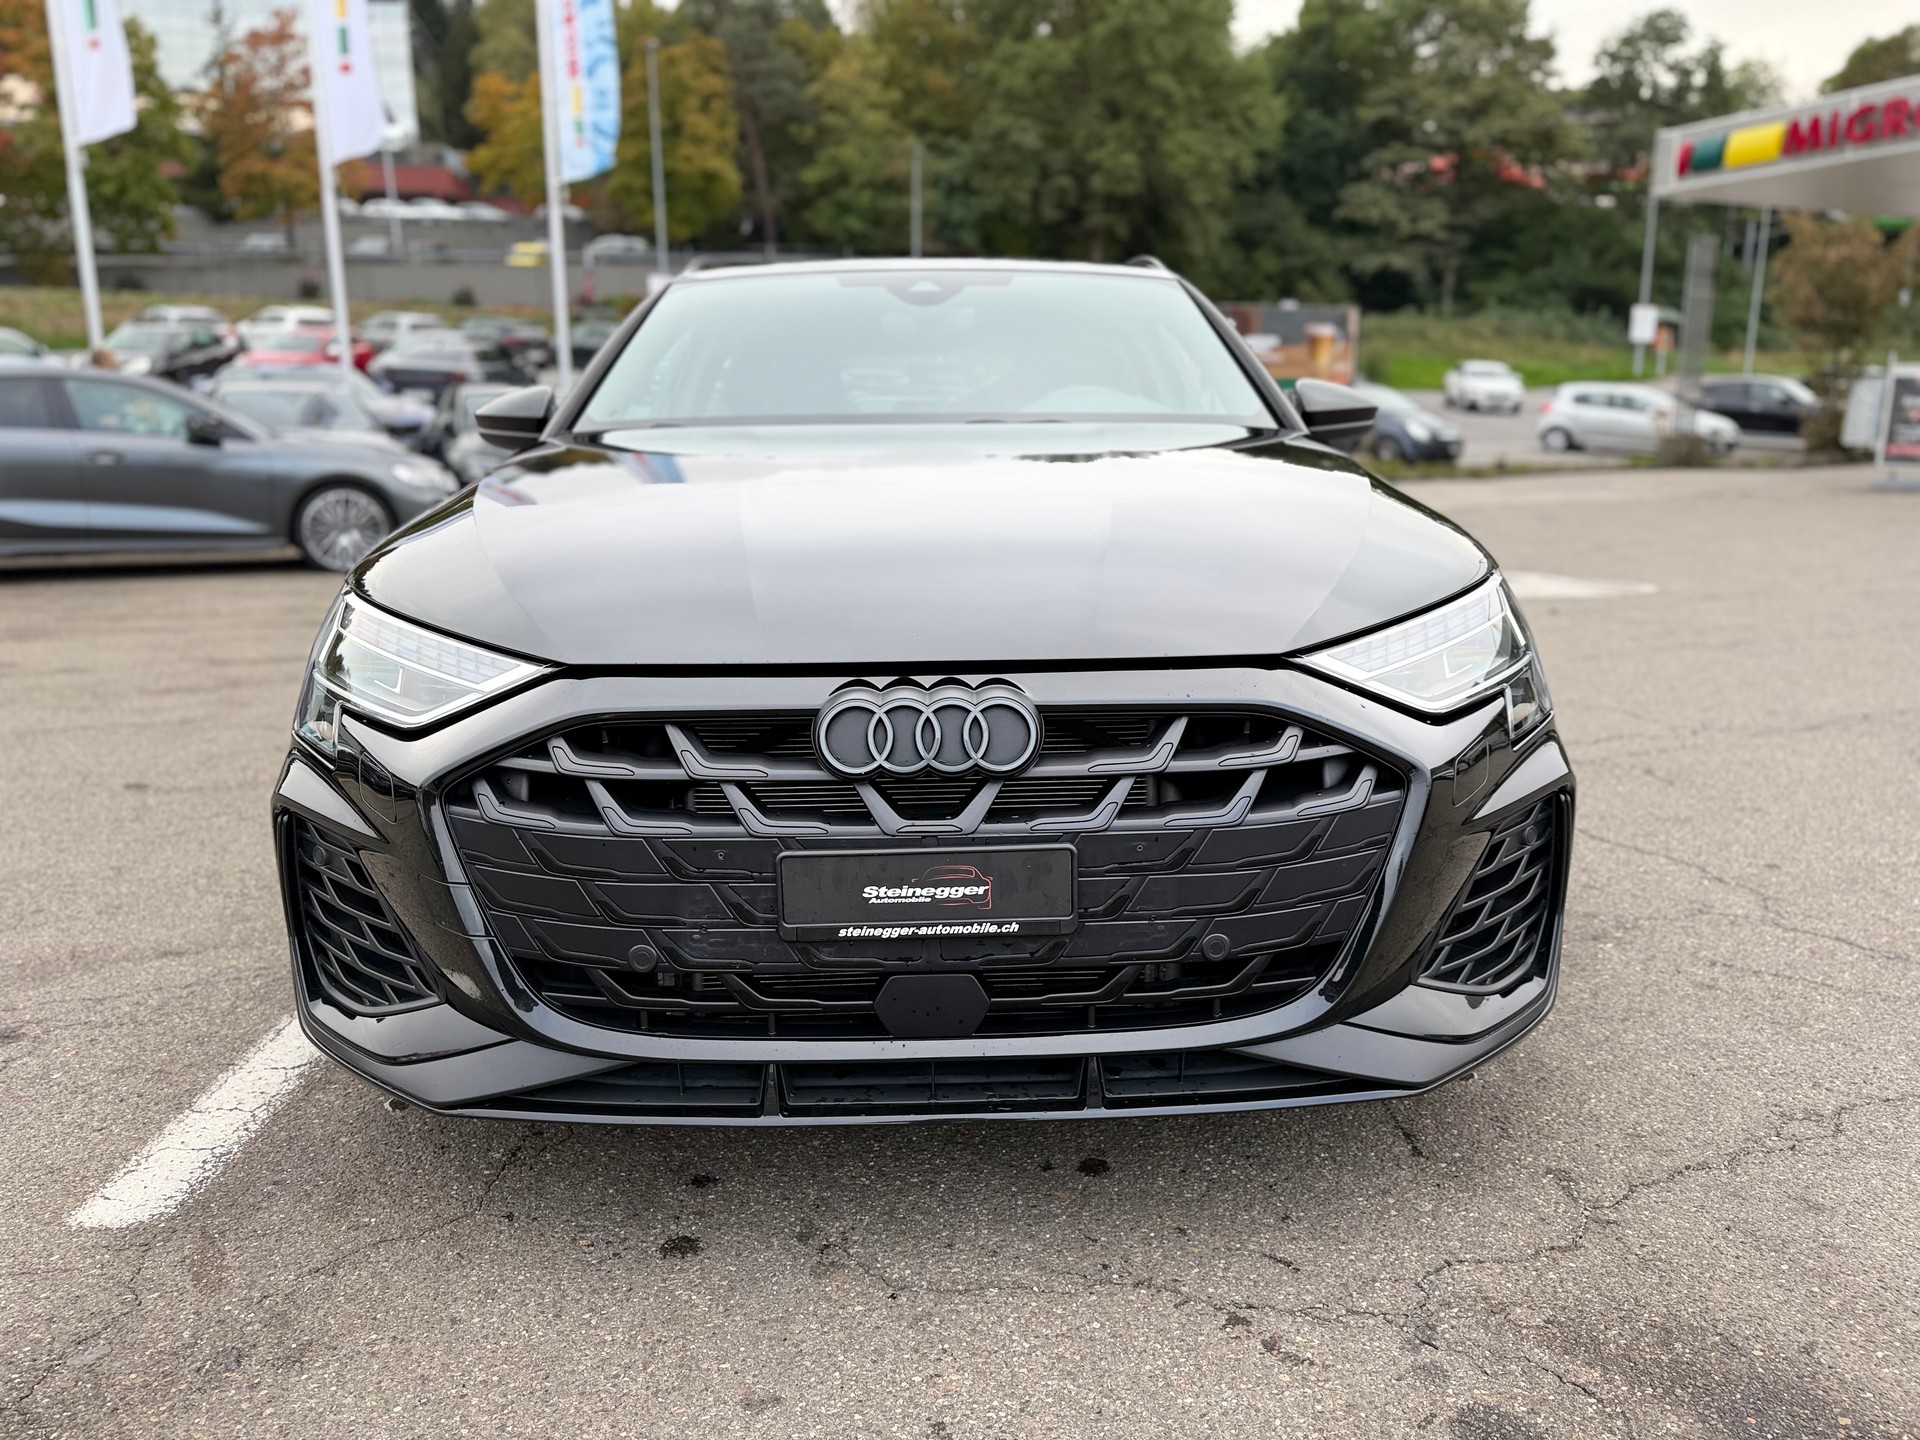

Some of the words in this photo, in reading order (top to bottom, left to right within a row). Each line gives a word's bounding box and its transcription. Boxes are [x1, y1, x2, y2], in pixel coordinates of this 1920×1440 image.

[1782, 97, 1920, 155] MIGR
[862, 885, 989, 899] Steinegger
[868, 896, 932, 904] Automobile
[838, 922, 1019, 938] steinegger-automobile.ch
